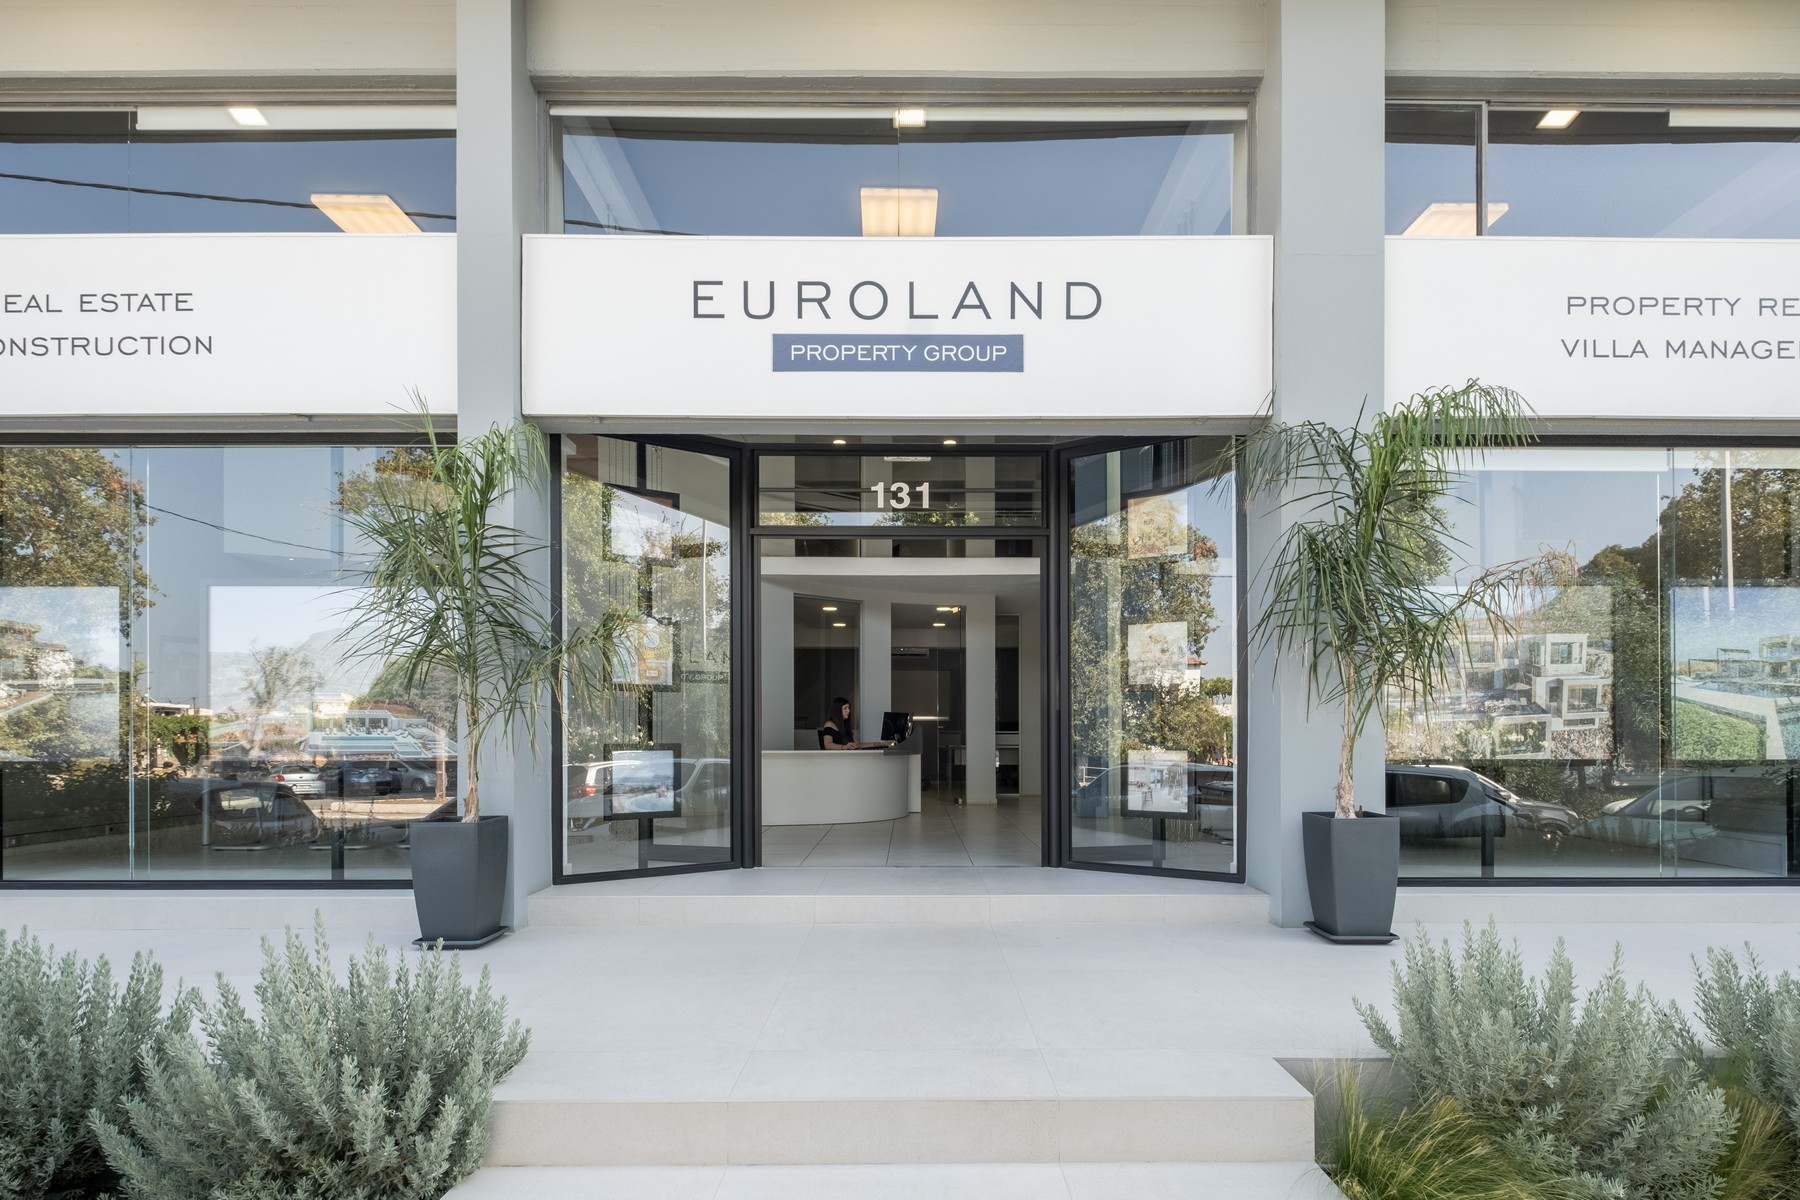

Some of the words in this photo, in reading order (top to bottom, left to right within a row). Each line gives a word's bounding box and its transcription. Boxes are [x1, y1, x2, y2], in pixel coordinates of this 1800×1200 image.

[79, 292, 194, 313] ESTATE
[693, 280, 1102, 321] EUROLAND
[1567, 296, 1741, 316] PROPERTY
[1759, 297, 1800, 317] RE
[0, 335, 213, 357] NSTRUCTION
[791, 344, 918, 361] PROPERTY
[923, 344, 1007, 362] GROUP
[1560, 339, 1649, 358] VILLA
[1666, 340, 1800, 360] MANAGE
[870, 482, 930, 509] 131
